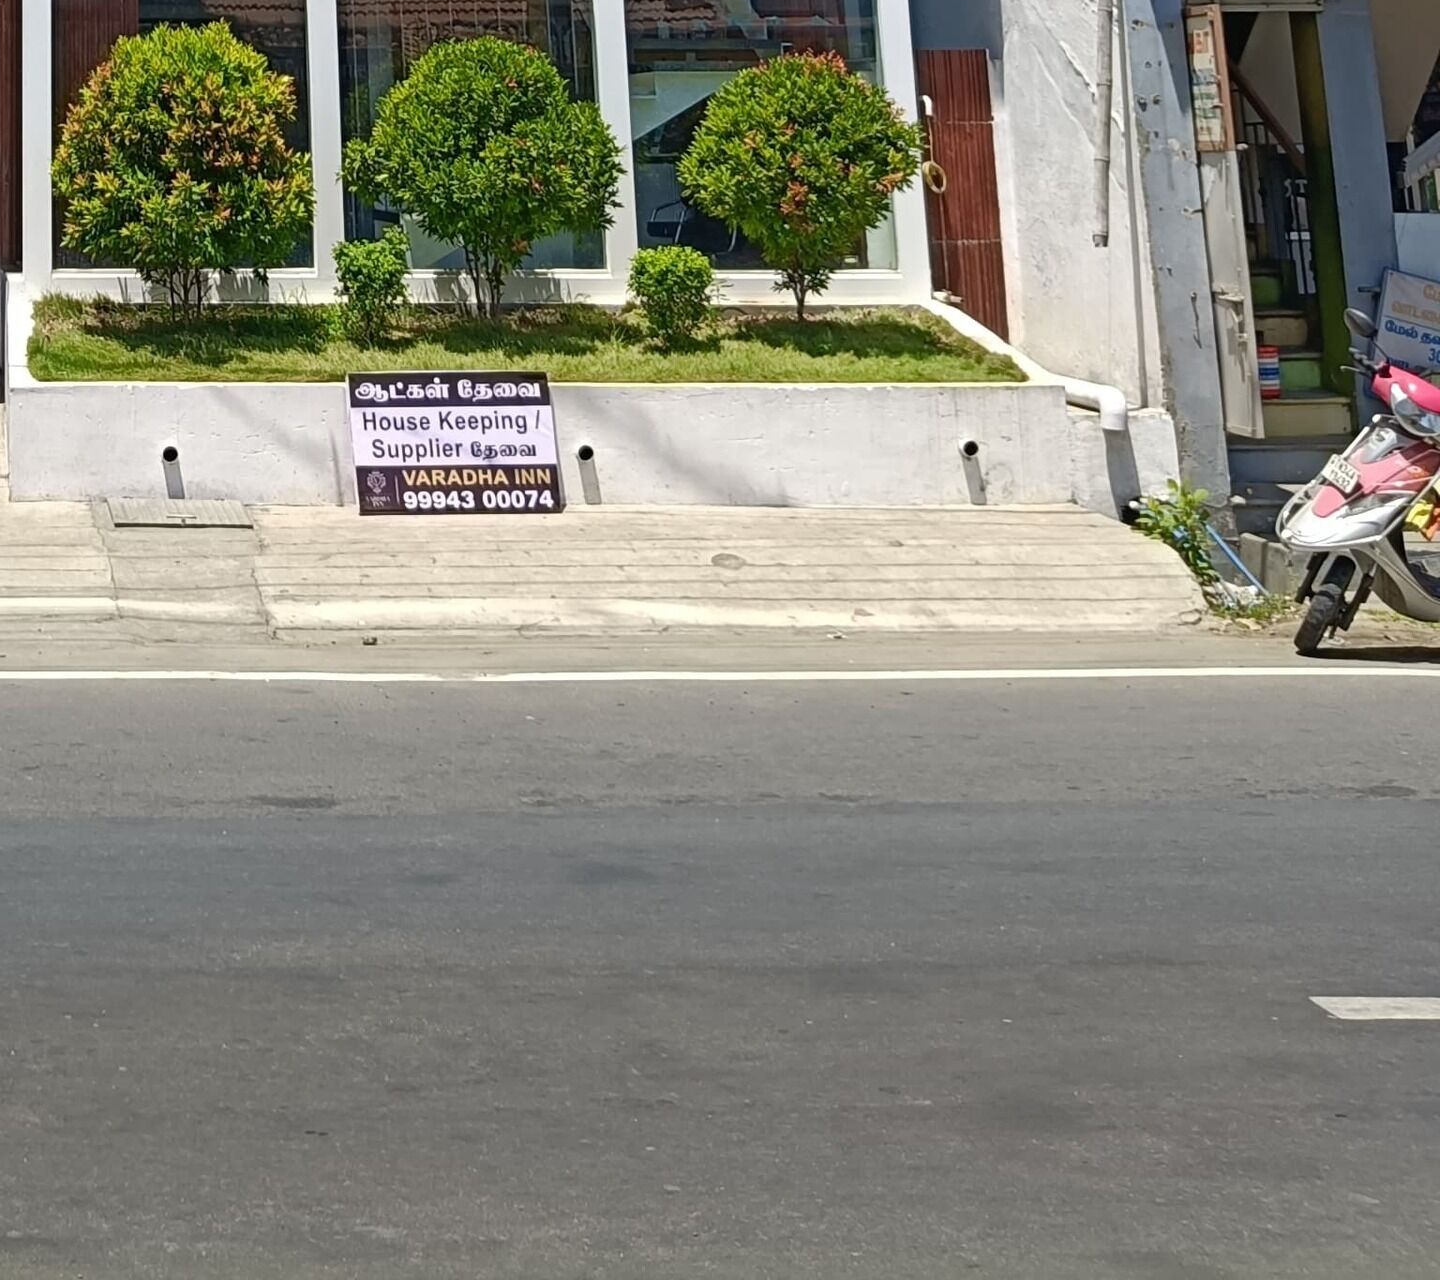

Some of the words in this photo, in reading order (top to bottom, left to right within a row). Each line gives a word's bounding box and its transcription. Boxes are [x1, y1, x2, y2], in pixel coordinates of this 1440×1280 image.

[354, 376, 450, 402] ஆட்கள்
[457, 378, 541, 402] தேவை
[362, 411, 431, 432] House
[439, 410, 527, 435] Keeping
[372, 438, 463, 463] Supplier
[470, 440, 537, 461] தேவை
[401, 469, 509, 486] VARADHA
[515, 468, 551, 485] INN
[403, 490, 476, 510] 99943
[482, 490, 555, 510] 00074
